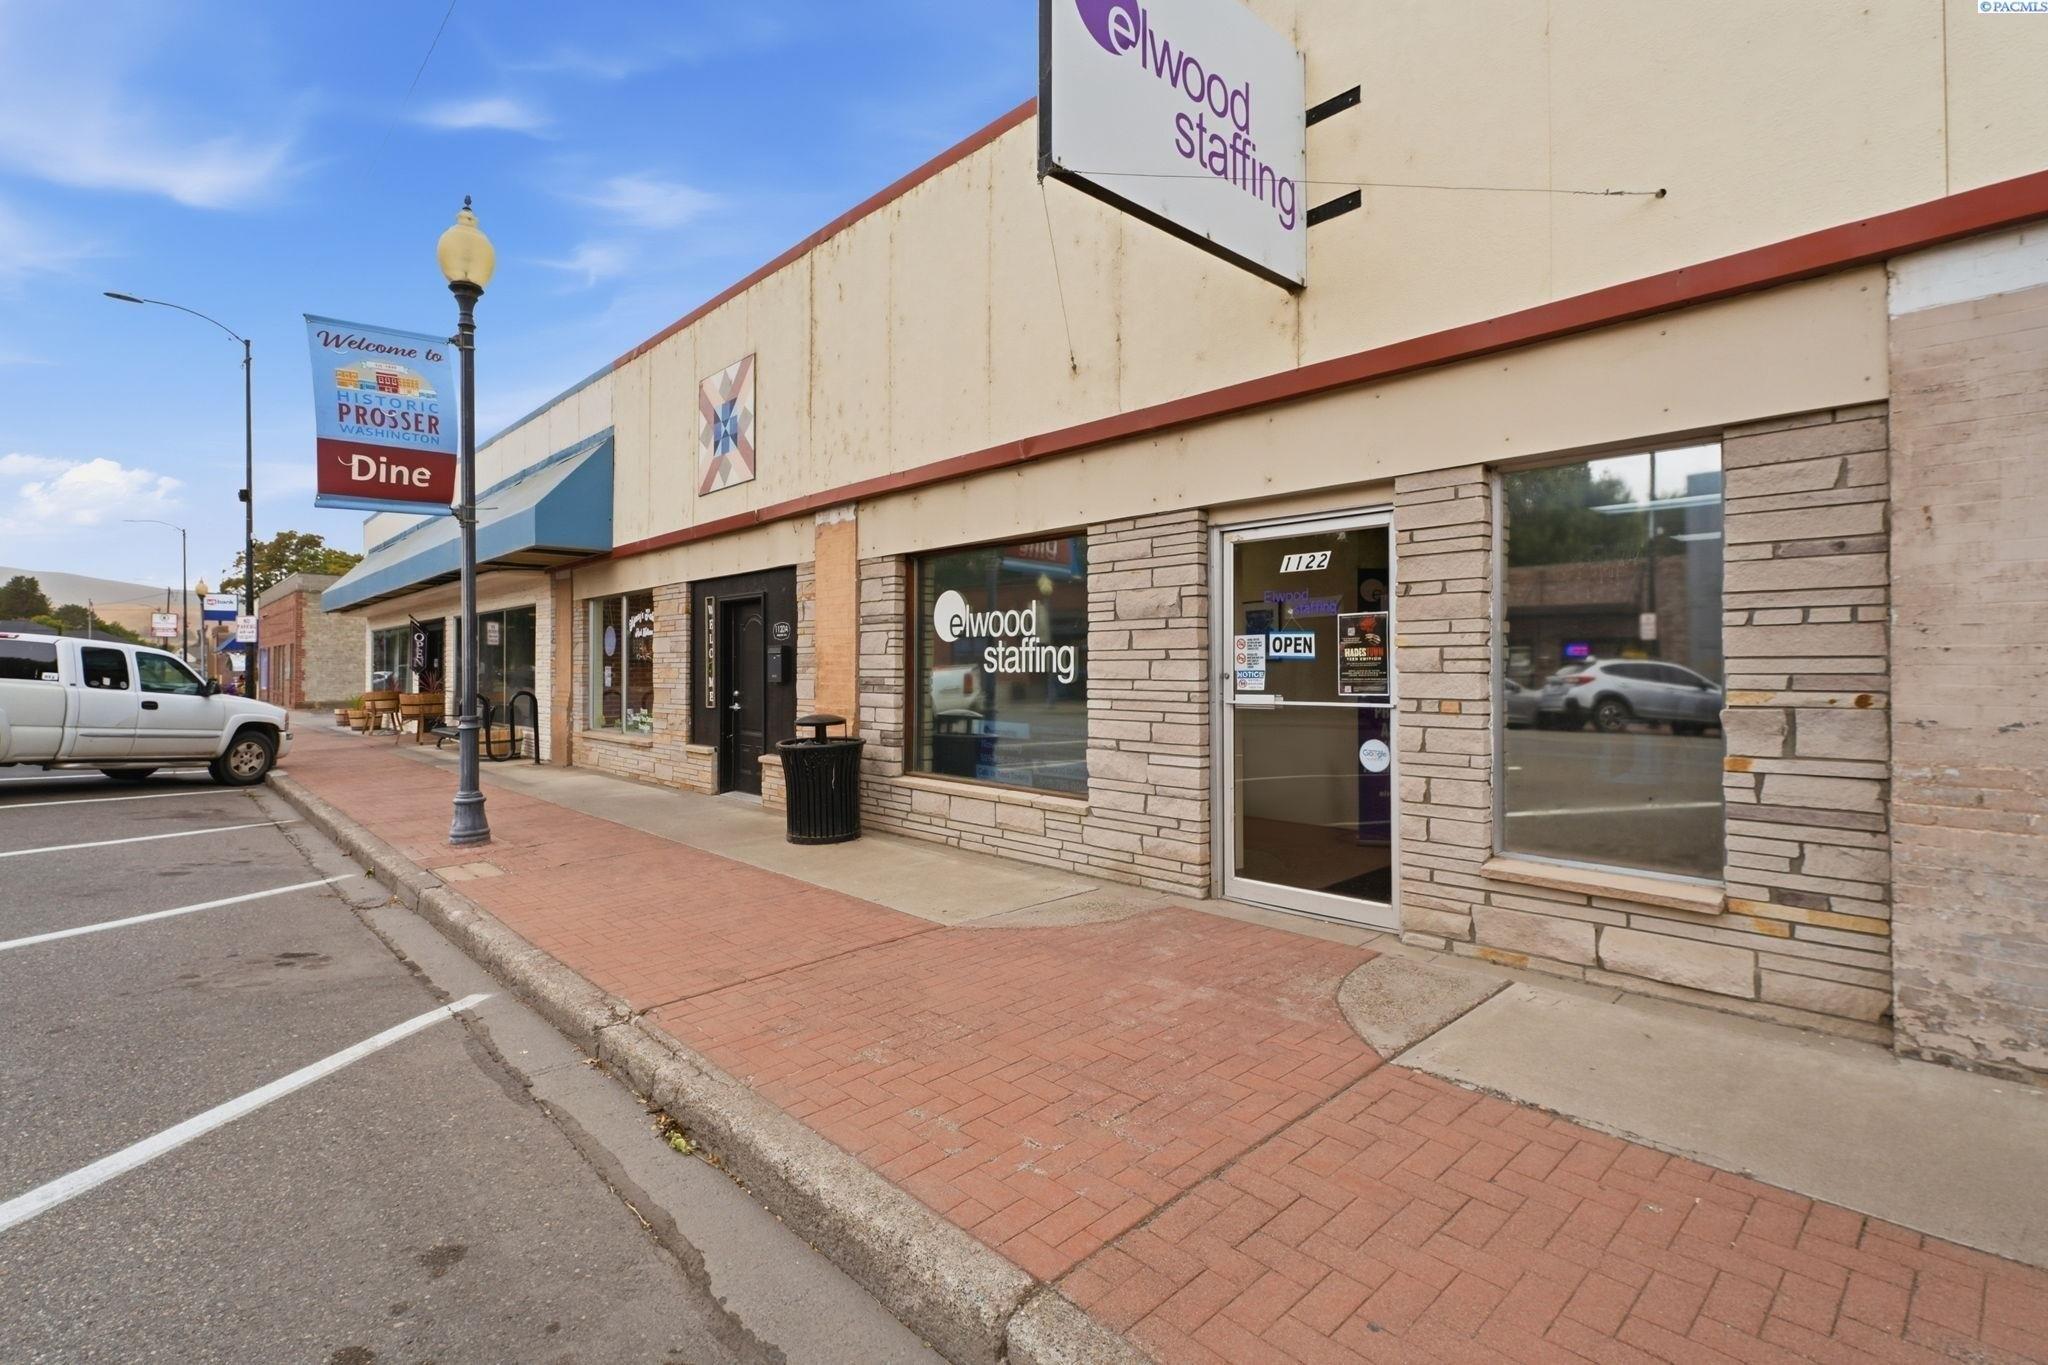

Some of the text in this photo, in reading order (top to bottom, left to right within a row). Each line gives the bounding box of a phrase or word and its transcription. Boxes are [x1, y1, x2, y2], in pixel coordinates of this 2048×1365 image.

[1107, 4, 1250, 135] elwood
[1175, 112, 1296, 231] staffing
[316, 330, 444, 363] Welcome to
[337, 391, 439, 414] HISTORIC
[338, 403, 440, 435] PROSSER
[340, 423, 440, 445] WASHINGTON
[338, 453, 432, 488] Dine
[1284, 552, 1328, 572] 1122
[949, 600, 1036, 638] elwood
[983, 637, 1075, 685] staffing
[1272, 636, 1313, 654] OPEN
[1362, 749, 1387, 759] Google
